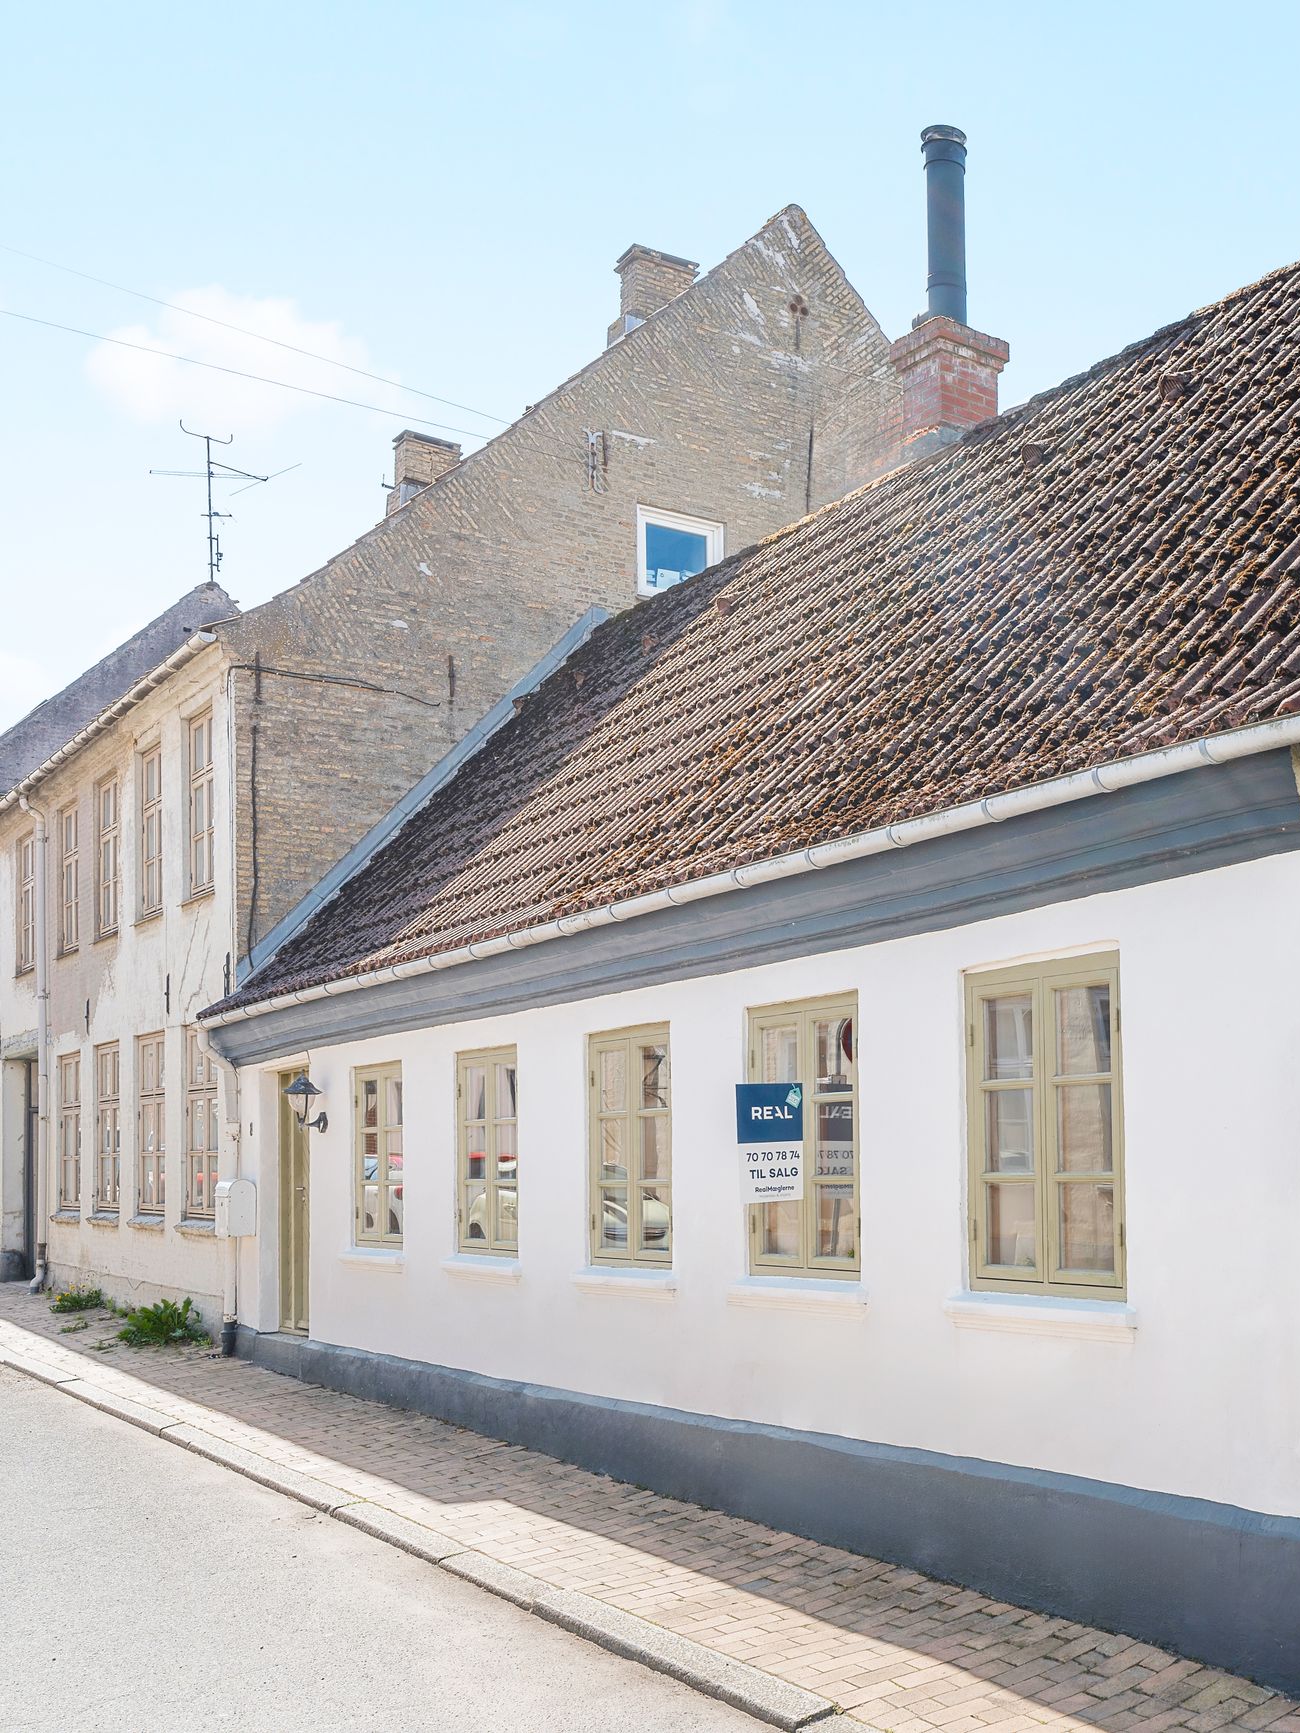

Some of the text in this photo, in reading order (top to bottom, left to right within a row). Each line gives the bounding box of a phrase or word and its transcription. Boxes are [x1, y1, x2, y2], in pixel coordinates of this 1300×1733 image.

[751, 1105, 793, 1120] REAL
[746, 1150, 800, 1162] 70 70 78 74
[749, 1167, 799, 1179] TIL SALG
